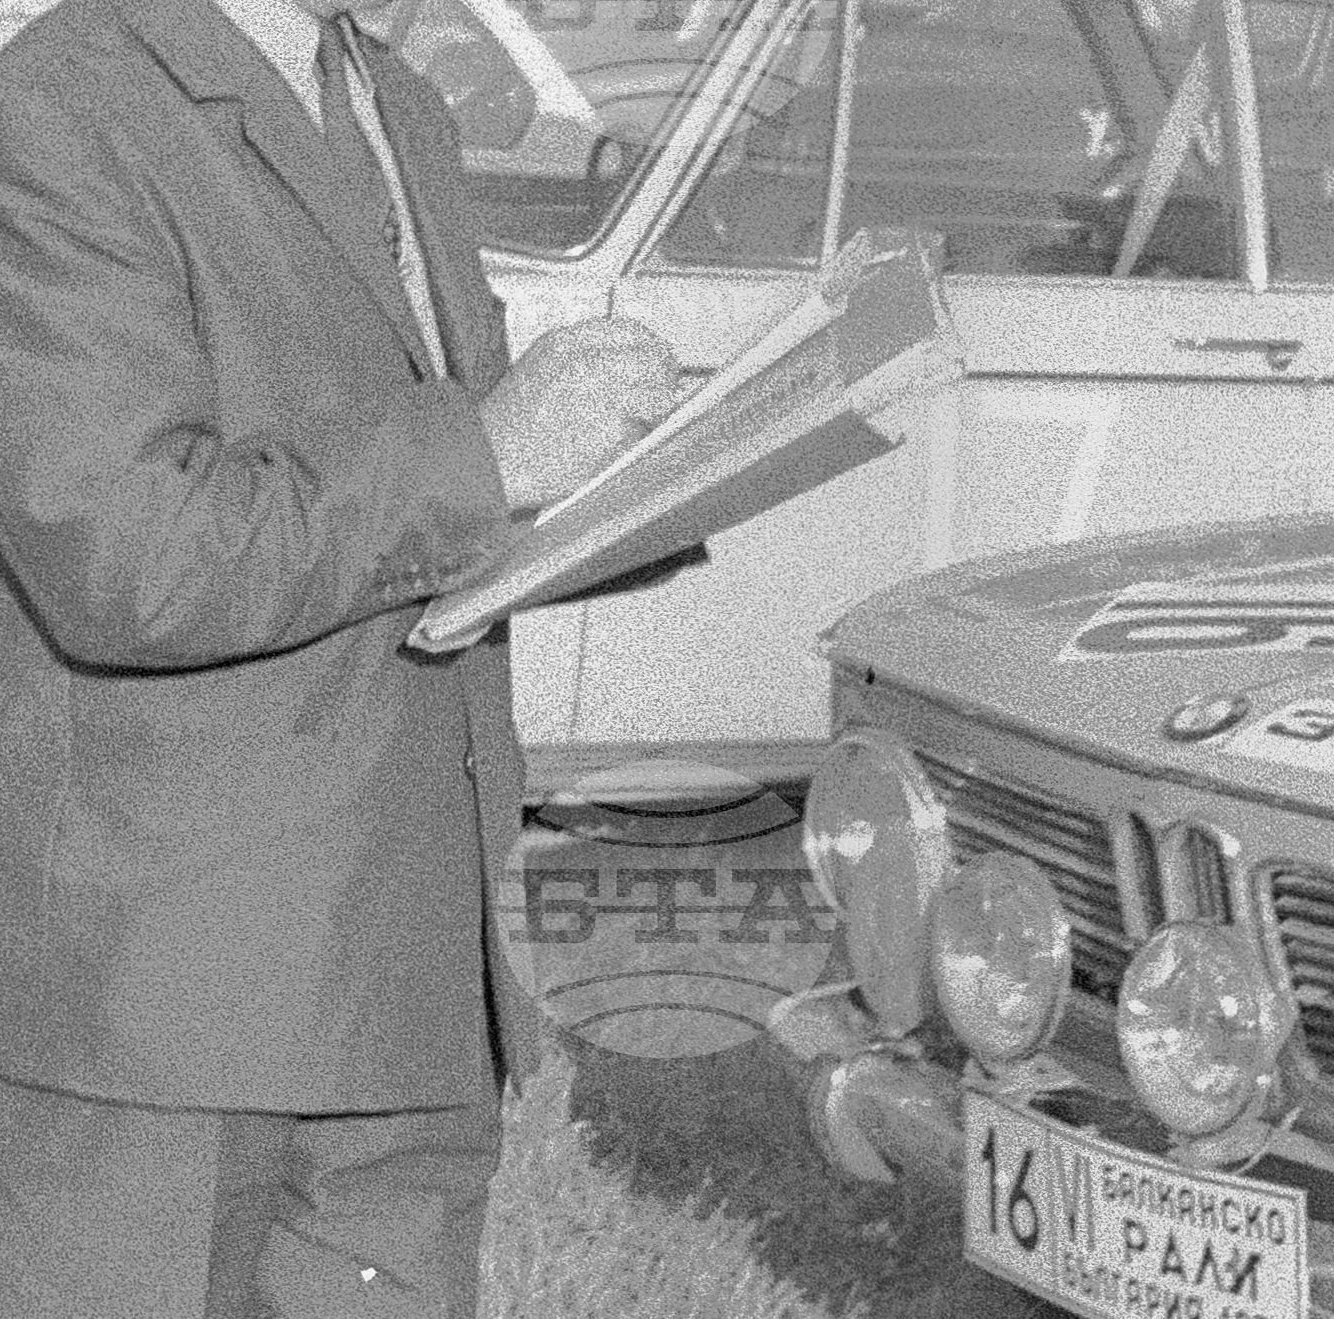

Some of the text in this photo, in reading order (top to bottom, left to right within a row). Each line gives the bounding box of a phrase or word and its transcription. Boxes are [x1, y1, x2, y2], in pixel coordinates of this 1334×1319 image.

[980, 1125, 1042, 1254] 16
[1052, 1141, 1097, 1253] VI
[1100, 1163, 1287, 1247] БАЛКАНСКО
[1122, 1216, 1262, 1303] РАЛИ
